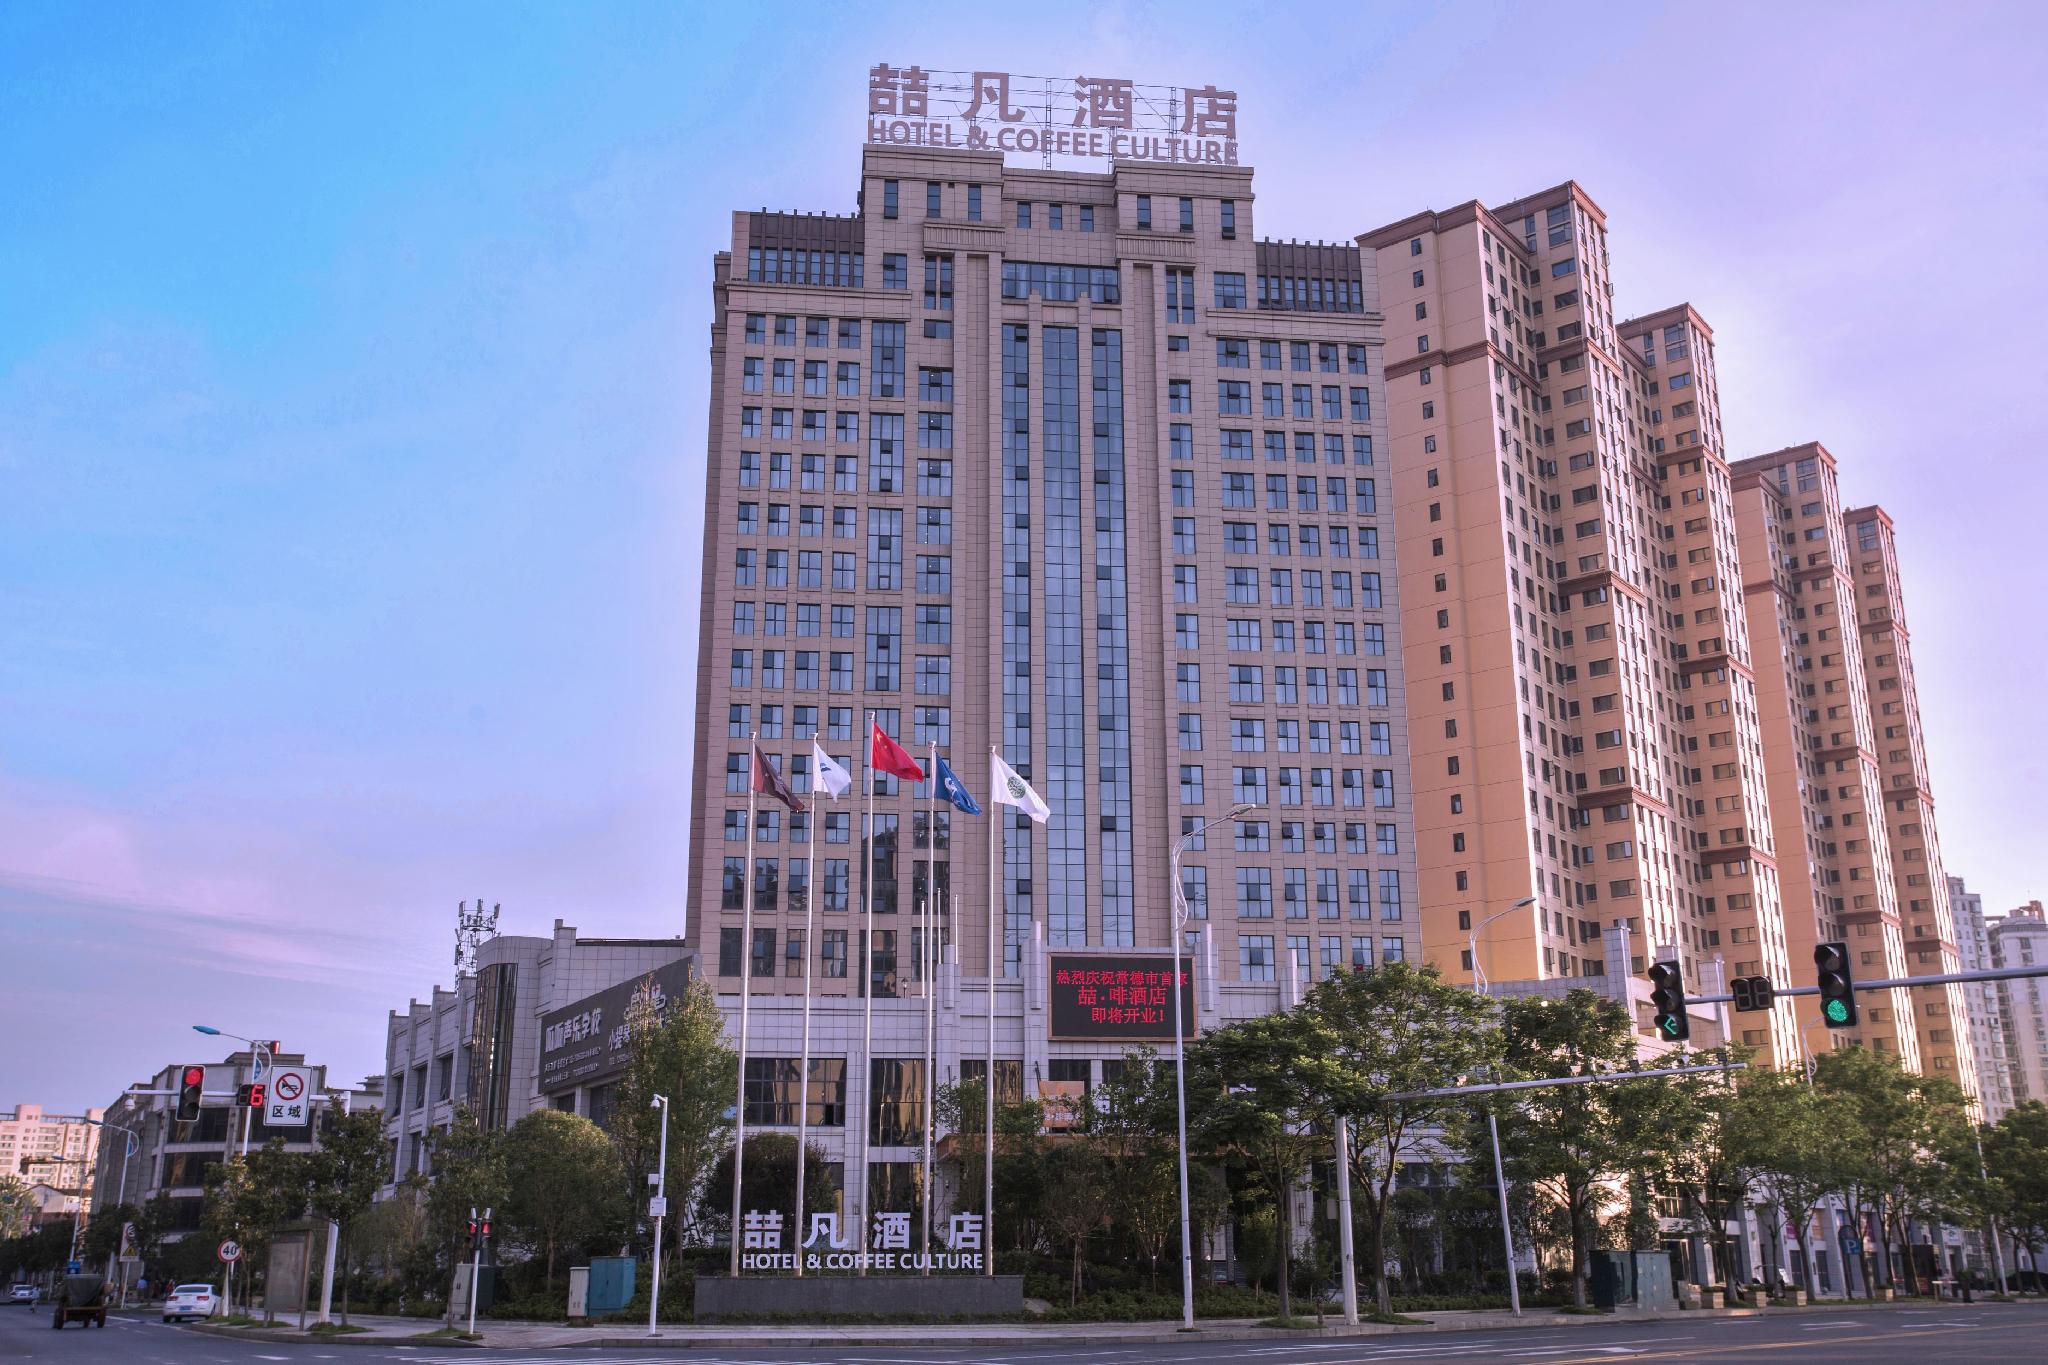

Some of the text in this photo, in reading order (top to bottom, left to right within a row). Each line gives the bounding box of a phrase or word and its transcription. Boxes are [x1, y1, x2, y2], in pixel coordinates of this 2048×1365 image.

[869, 63, 1238, 140] 喆凡酒店
[867, 119, 1239, 166] HOTEL & COFFEE CULTURE
[272, 1105, 301, 1118] 区域
[744, 1209, 983, 1250] 喆凡酒店
[222, 1245, 238, 1256] 40
[742, 1253, 983, 1269] HOTEL & COFFEE CULTURE
